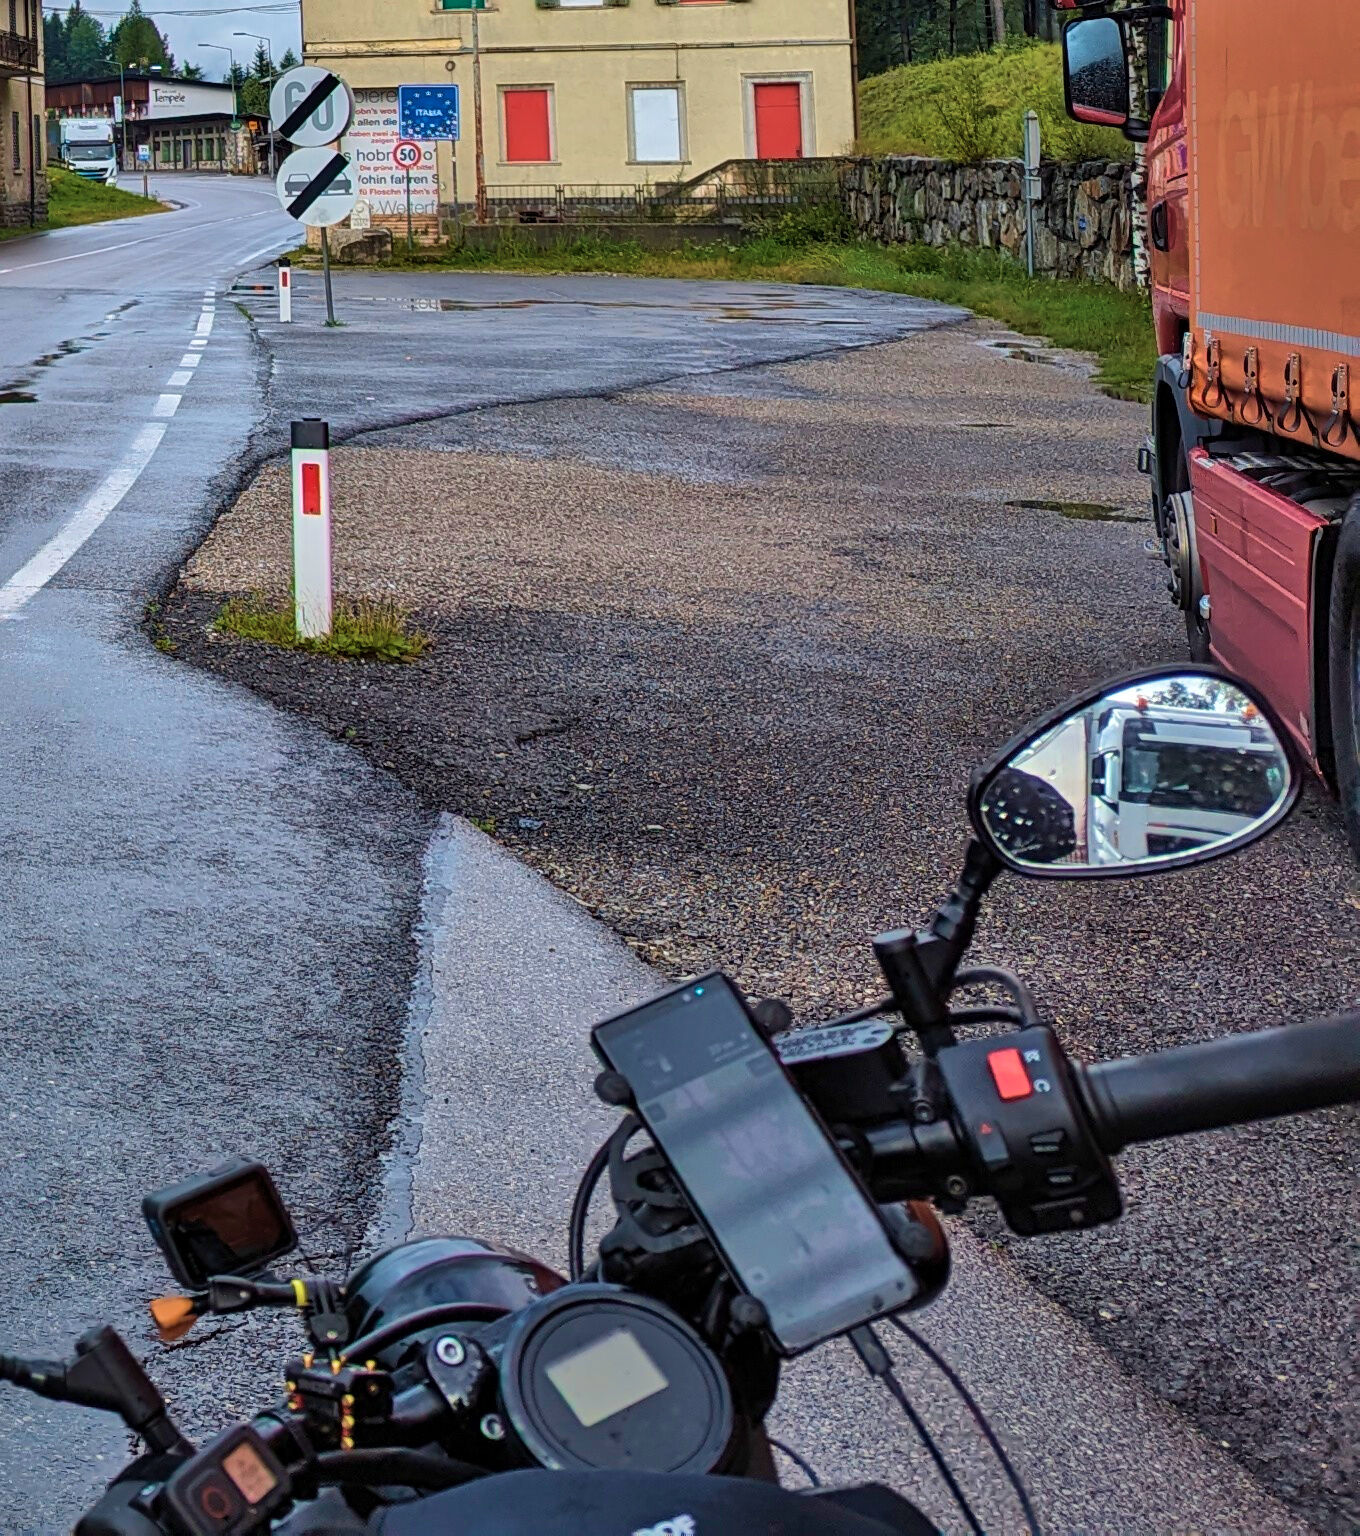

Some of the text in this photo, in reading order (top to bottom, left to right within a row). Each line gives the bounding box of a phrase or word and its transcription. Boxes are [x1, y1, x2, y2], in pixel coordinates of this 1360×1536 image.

[285, 81, 335, 132] 60
[415, 108, 443, 116] ITALIA
[400, 149, 416, 162] 50
